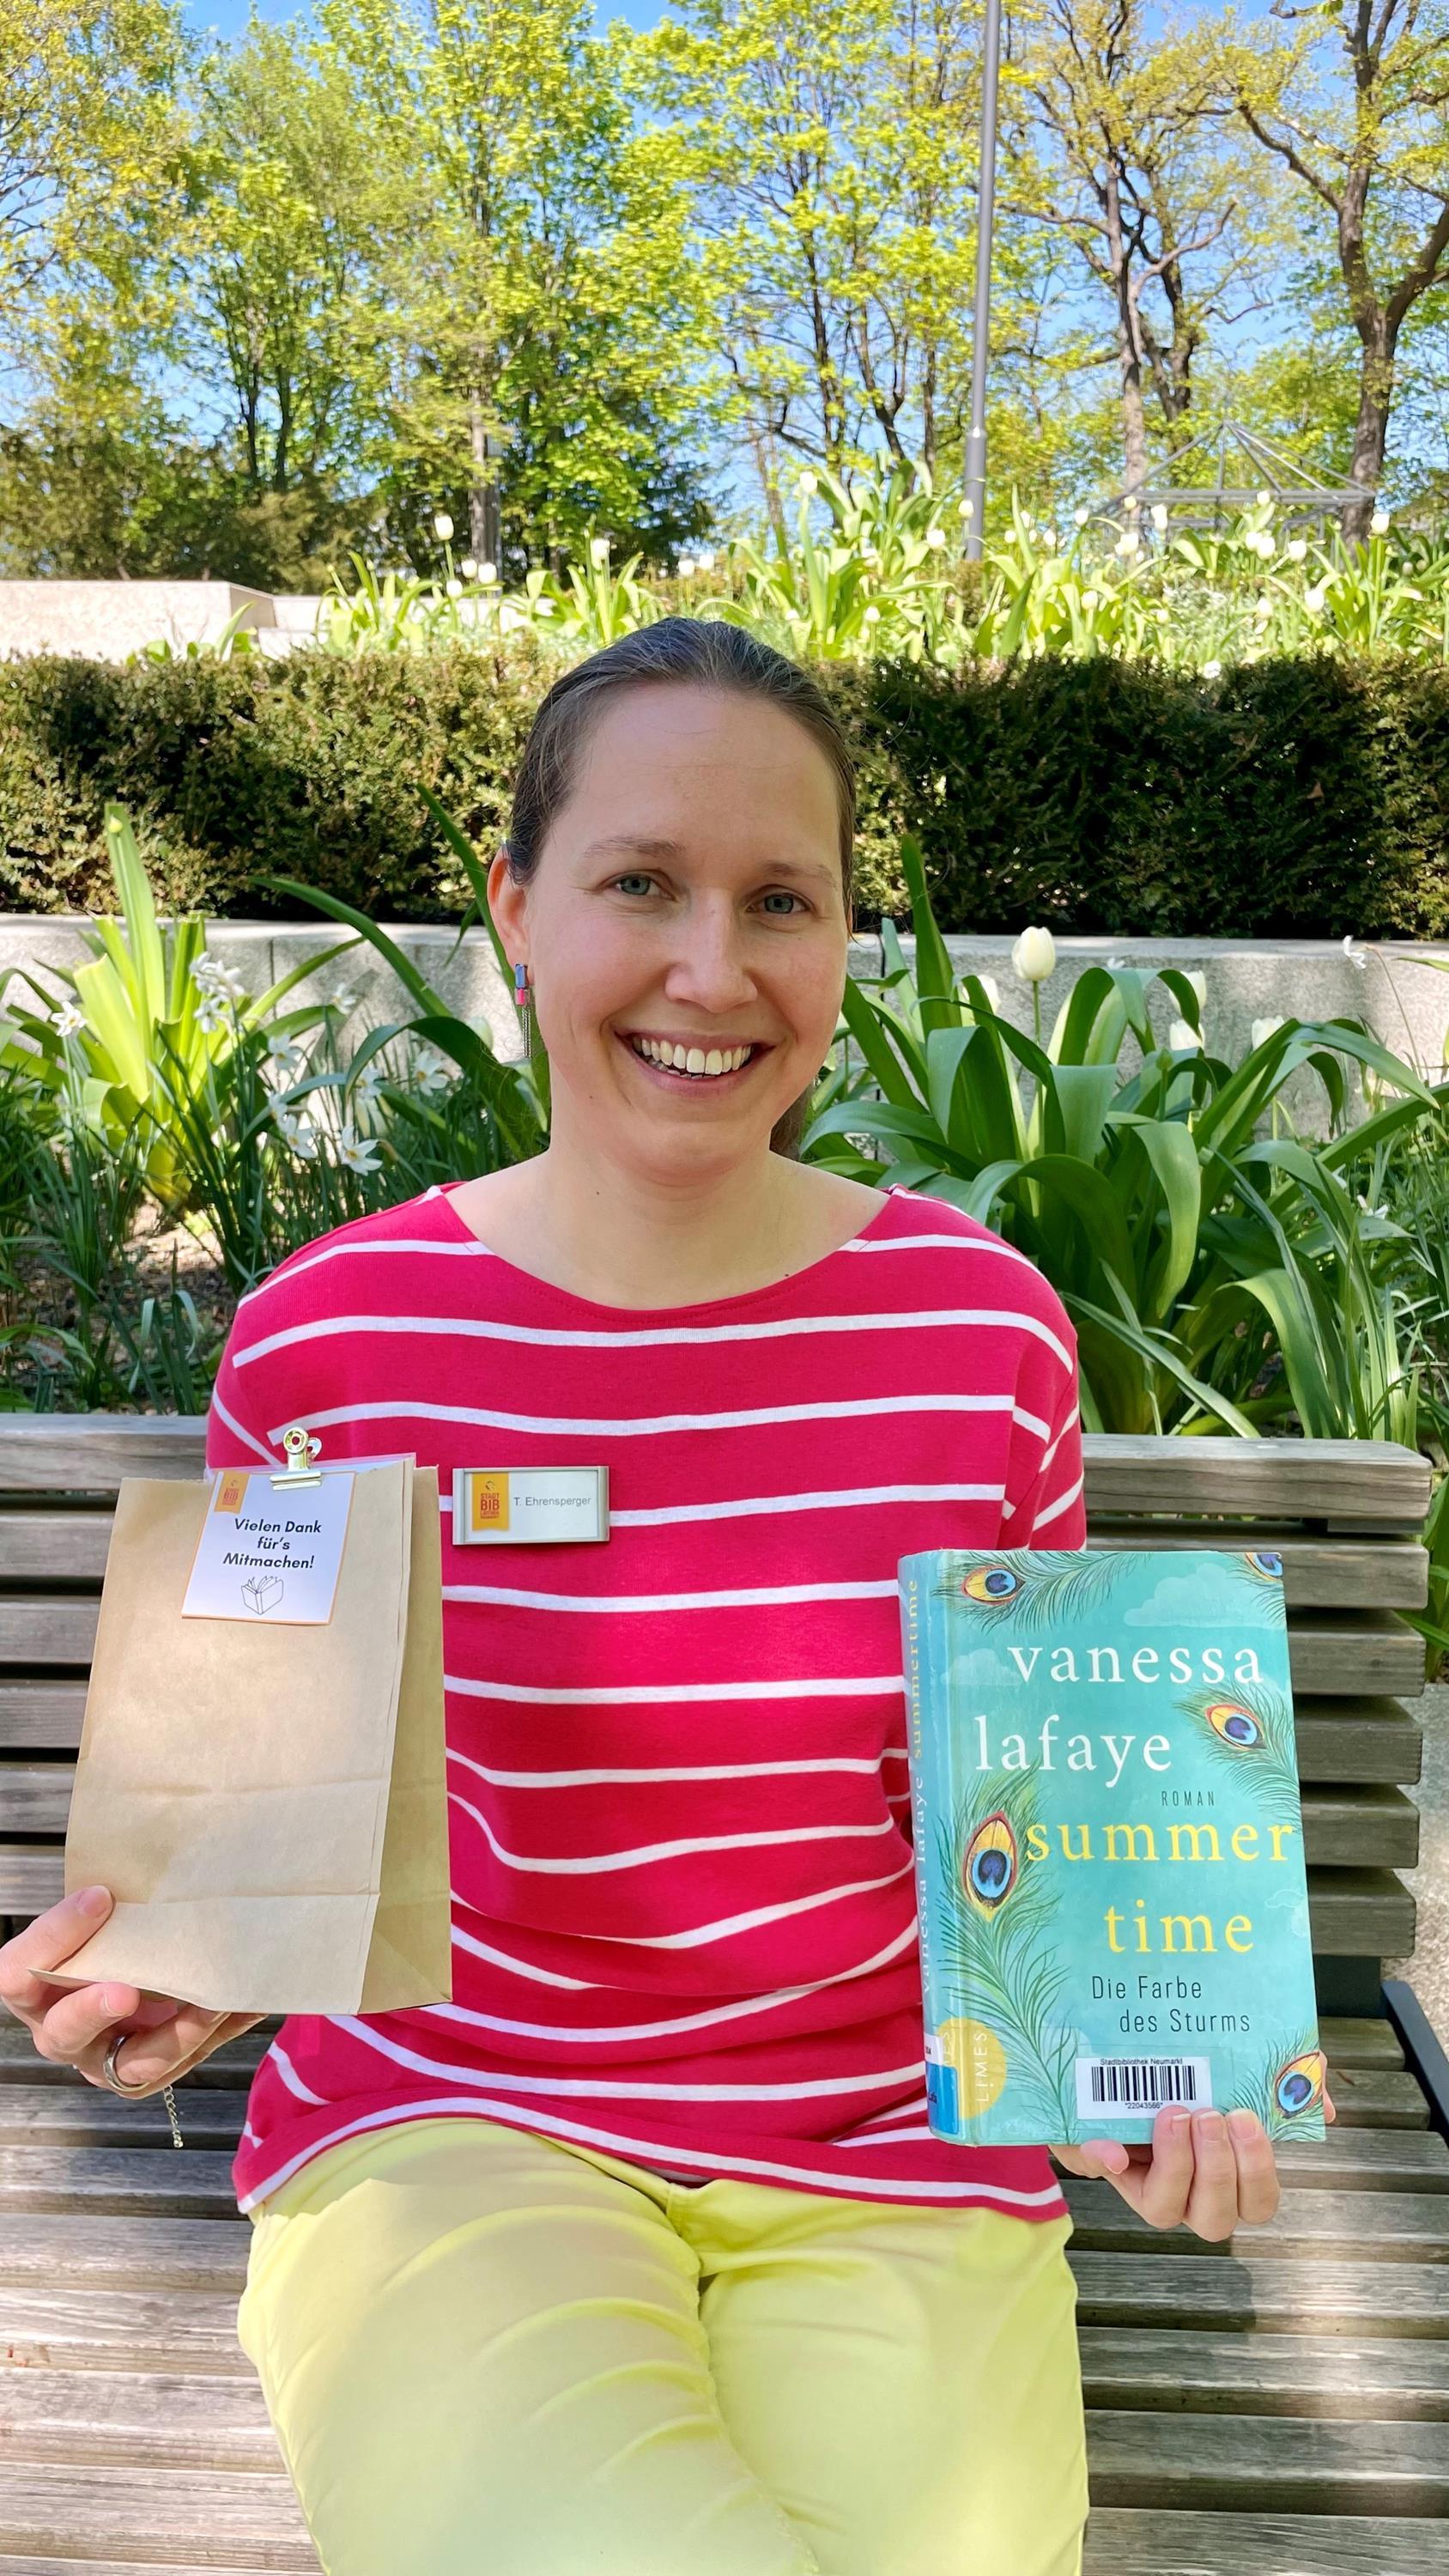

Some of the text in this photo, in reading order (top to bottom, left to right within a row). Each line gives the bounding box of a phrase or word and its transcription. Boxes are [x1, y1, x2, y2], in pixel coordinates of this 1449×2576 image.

[481, 1499, 500, 1510] BIB
[513, 1496, 591, 1508] T. Ehrensperger
[234, 1517, 322, 1534] Vielen Dank
[222, 1552, 315, 1569] Mitmachen!
[1006, 1645, 1264, 1684] vanessa
[974, 1714, 1173, 1788] lafaye
[908, 1580, 928, 1994] vanessa lafaye summertime
[1161, 1790, 1216, 1807] ROMAN
[1025, 1821, 1294, 1862] summer
[1104, 1899, 1256, 1954] time
[1092, 1976, 1203, 2000] Die Farbe
[1119, 2009, 1251, 2033] des Sturms
